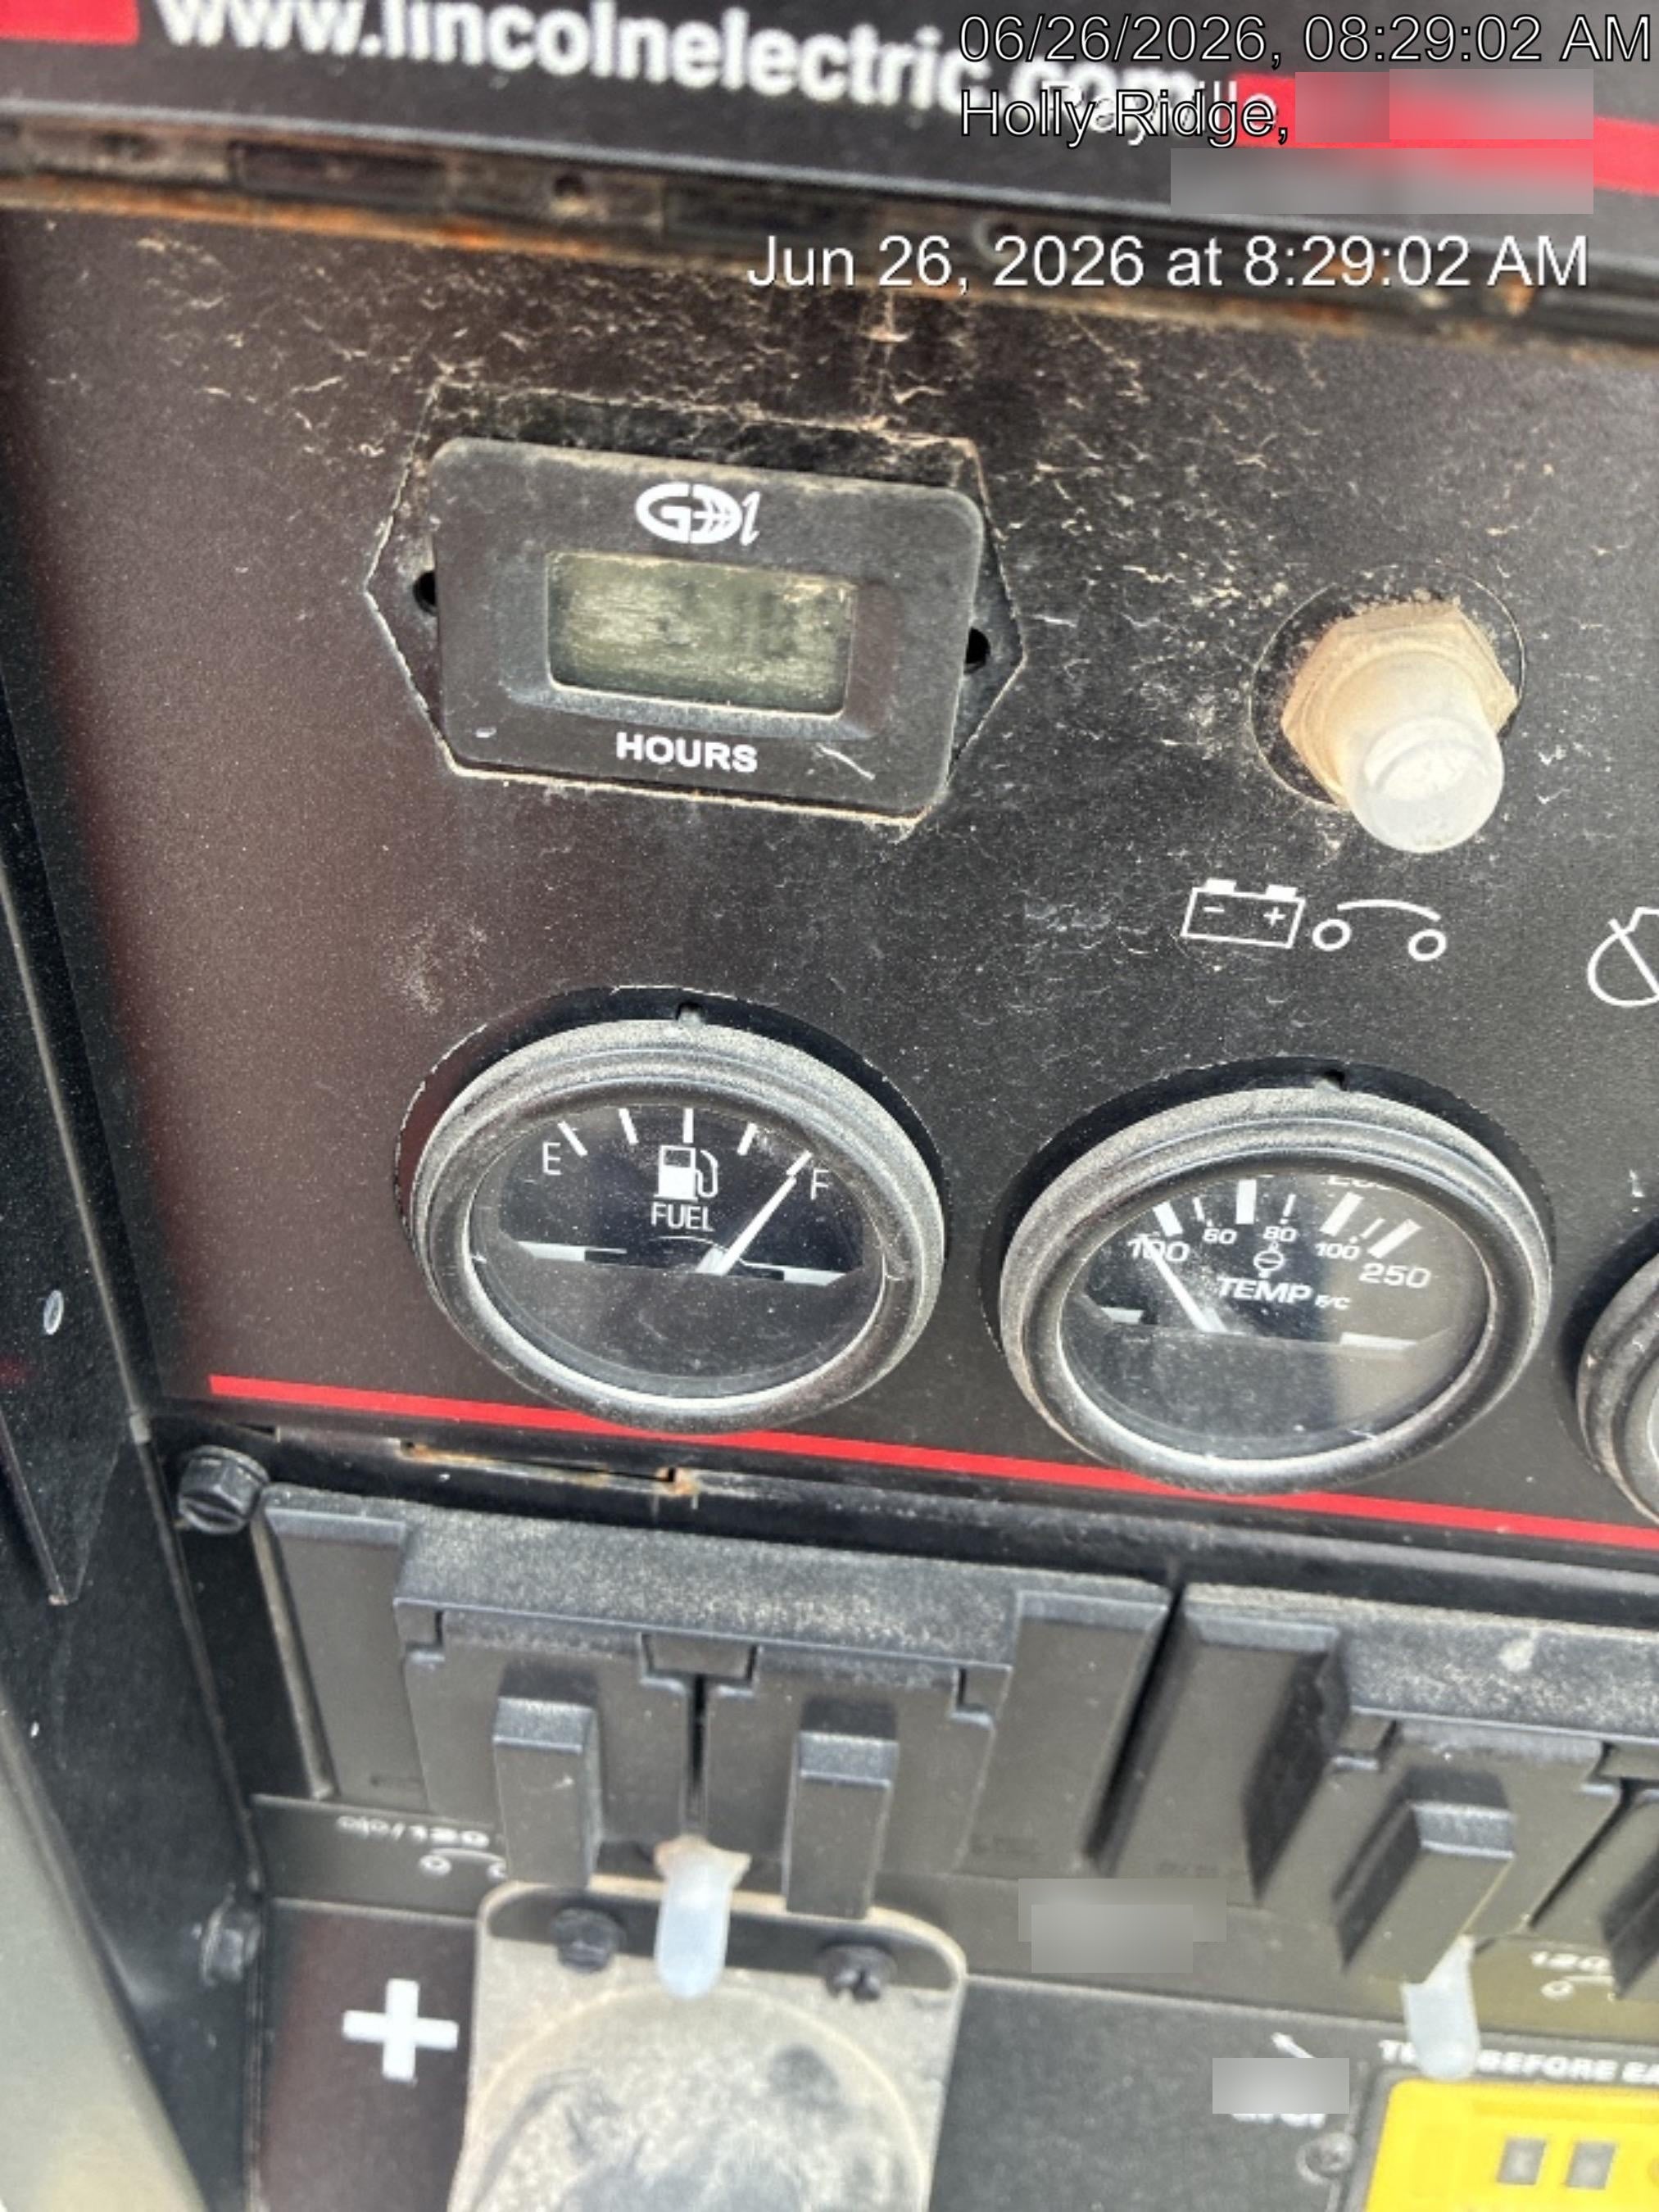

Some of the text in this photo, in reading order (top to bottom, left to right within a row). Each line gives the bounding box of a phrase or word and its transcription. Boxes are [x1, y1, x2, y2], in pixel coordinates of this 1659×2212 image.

[616, 732, 758, 773] HOURS
[542, 1141, 562, 1176] E
[809, 1168, 830, 1200] F
[650, 1201, 714, 1232] FUEL
[1262, 1226, 1298, 1243] 80
[1315, 1243, 1360, 1260] 100
[1216, 1276, 1312, 1305] TEMP
[1358, 1262, 1432, 1290] 250
[1476, 2049, 1619, 2082] BEFORE
